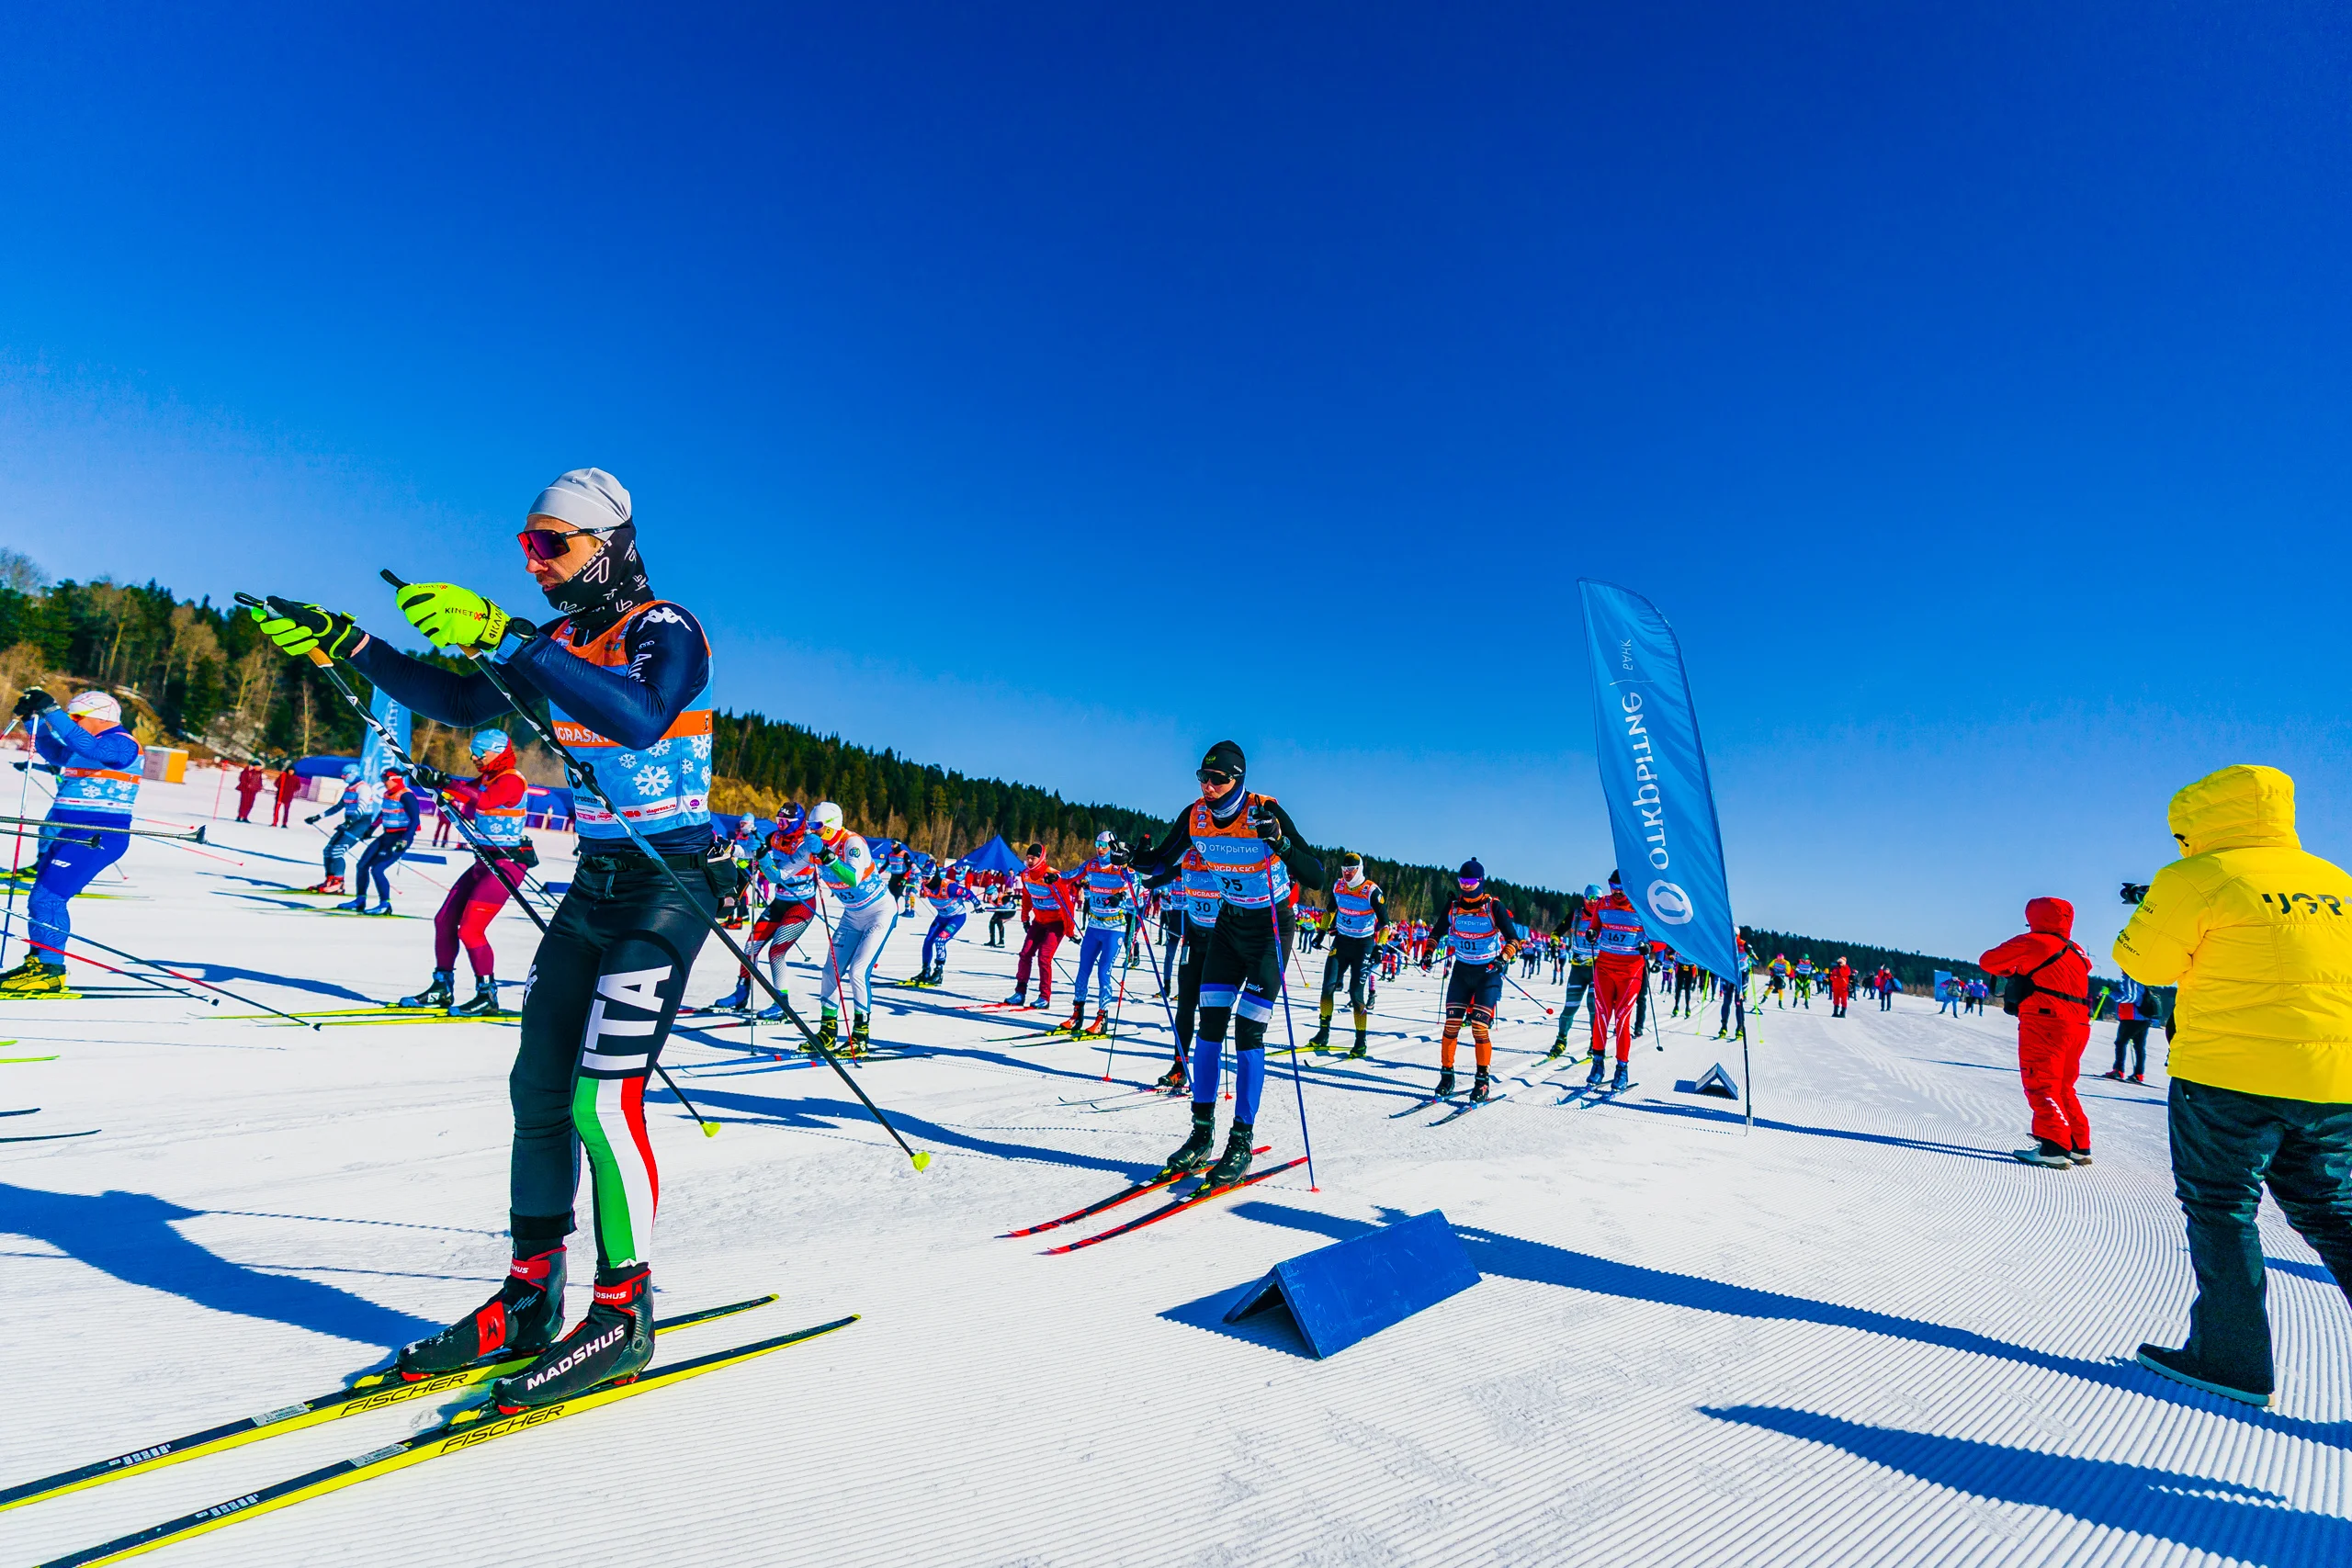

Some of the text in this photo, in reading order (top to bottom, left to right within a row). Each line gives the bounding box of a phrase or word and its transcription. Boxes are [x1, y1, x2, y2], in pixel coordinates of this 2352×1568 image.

[554, 727, 610, 743] GRASK
[1209, 844, 1260, 855] открытие
[1221, 876, 1243, 892] 95
[1195, 901, 1211, 912] 30
[1461, 941, 1476, 950] 101
[1608, 933, 1626, 942] 167
[582, 965, 673, 1071] ITA
[594, 1291, 628, 1300] ADSHUS
[527, 1324, 625, 1391] MADSHUS
[340, 1373, 469, 1416] FISCHER
[440, 1404, 565, 1453] FISCHER
